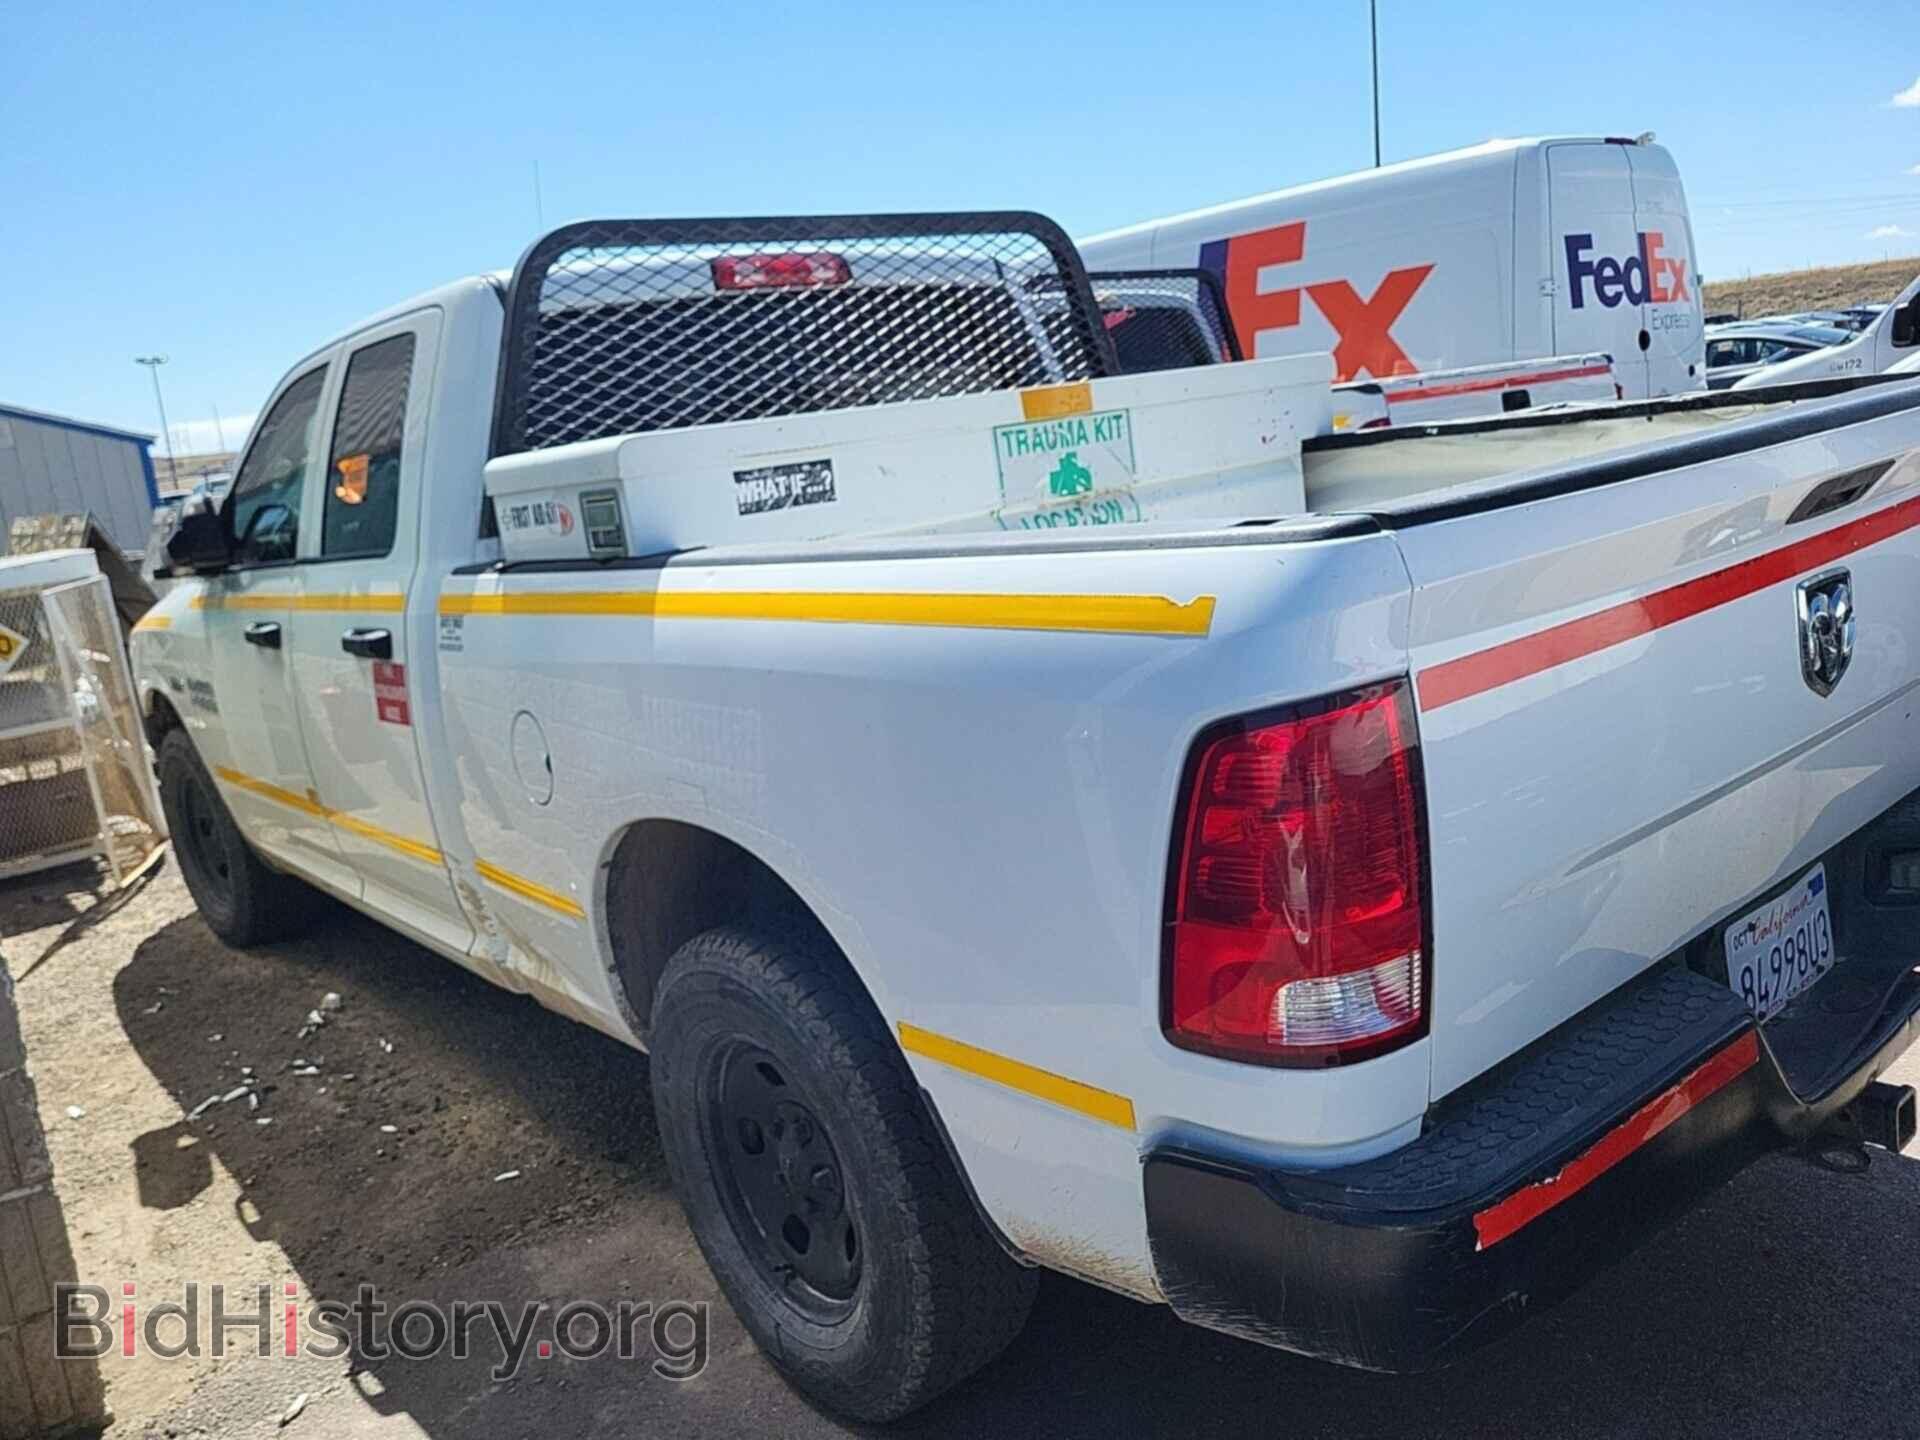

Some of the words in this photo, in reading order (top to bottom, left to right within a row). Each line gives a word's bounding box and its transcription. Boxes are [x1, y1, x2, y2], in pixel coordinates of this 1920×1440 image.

[1564, 232, 1691, 309] FedEx
[1002, 418, 1089, 457] TRAUMA
[1094, 414, 1124, 442] KIT
[735, 475, 787, 505] WHAT
[1733, 926, 1749, 951] OCT
[1752, 895, 1808, 946] California
[1740, 909, 1829, 1016] 84998U3
